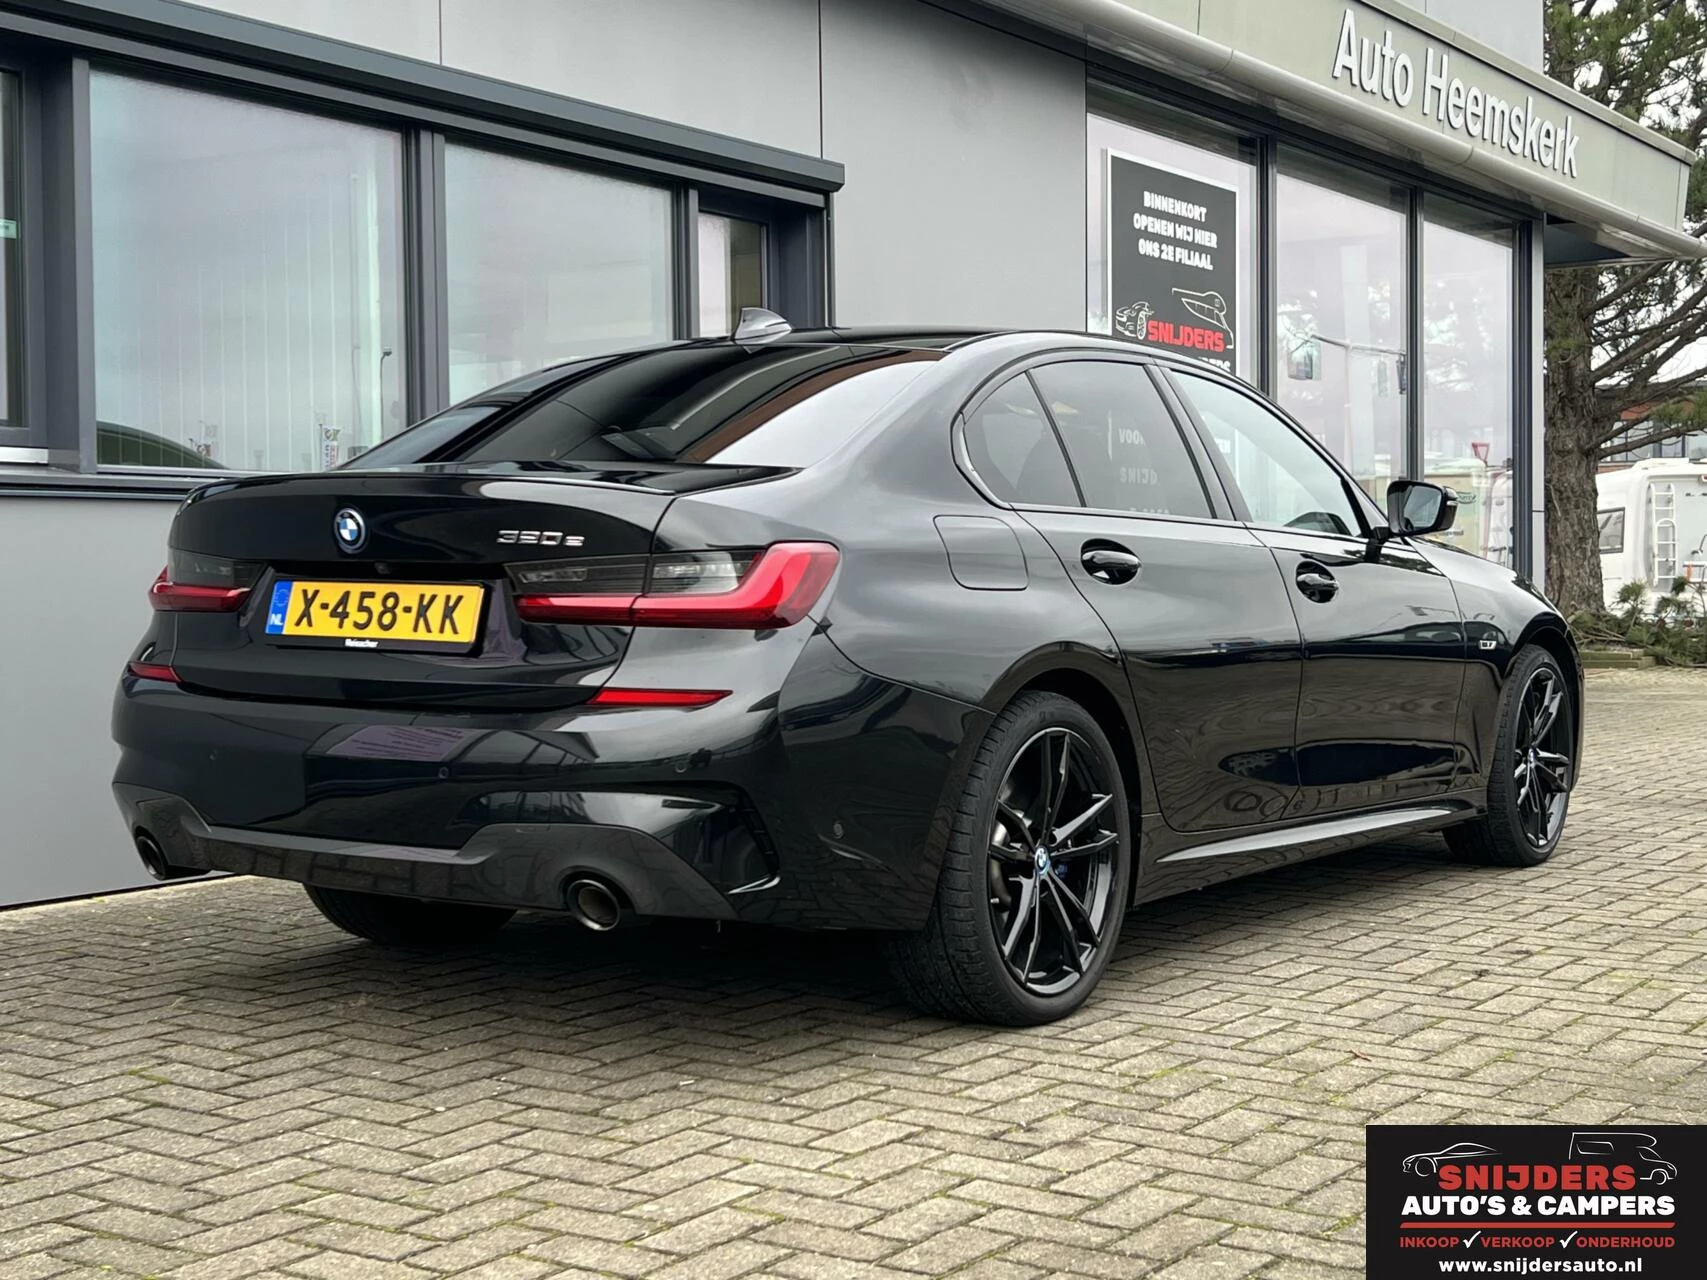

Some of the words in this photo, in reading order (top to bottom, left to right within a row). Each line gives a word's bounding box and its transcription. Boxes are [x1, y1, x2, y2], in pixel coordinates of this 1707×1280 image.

[1332, 8, 1414, 107] Auto
[1422, 47, 1580, 178] Heemskerk
[1143, 190, 1207, 222] BINNENKORT
[1133, 212, 1175, 238] OPENEN
[1175, 223, 1194, 242] WIJ
[1194, 228, 1218, 248] HIER
[1138, 238, 1160, 258] ONS
[1160, 243, 1175, 262] 2E
[1175, 246, 1214, 271] FILIAAL
[1147, 319, 1225, 353] SNIJDERS
[270, 613, 283, 626] NL
[294, 588, 464, 635] X-458-KK
